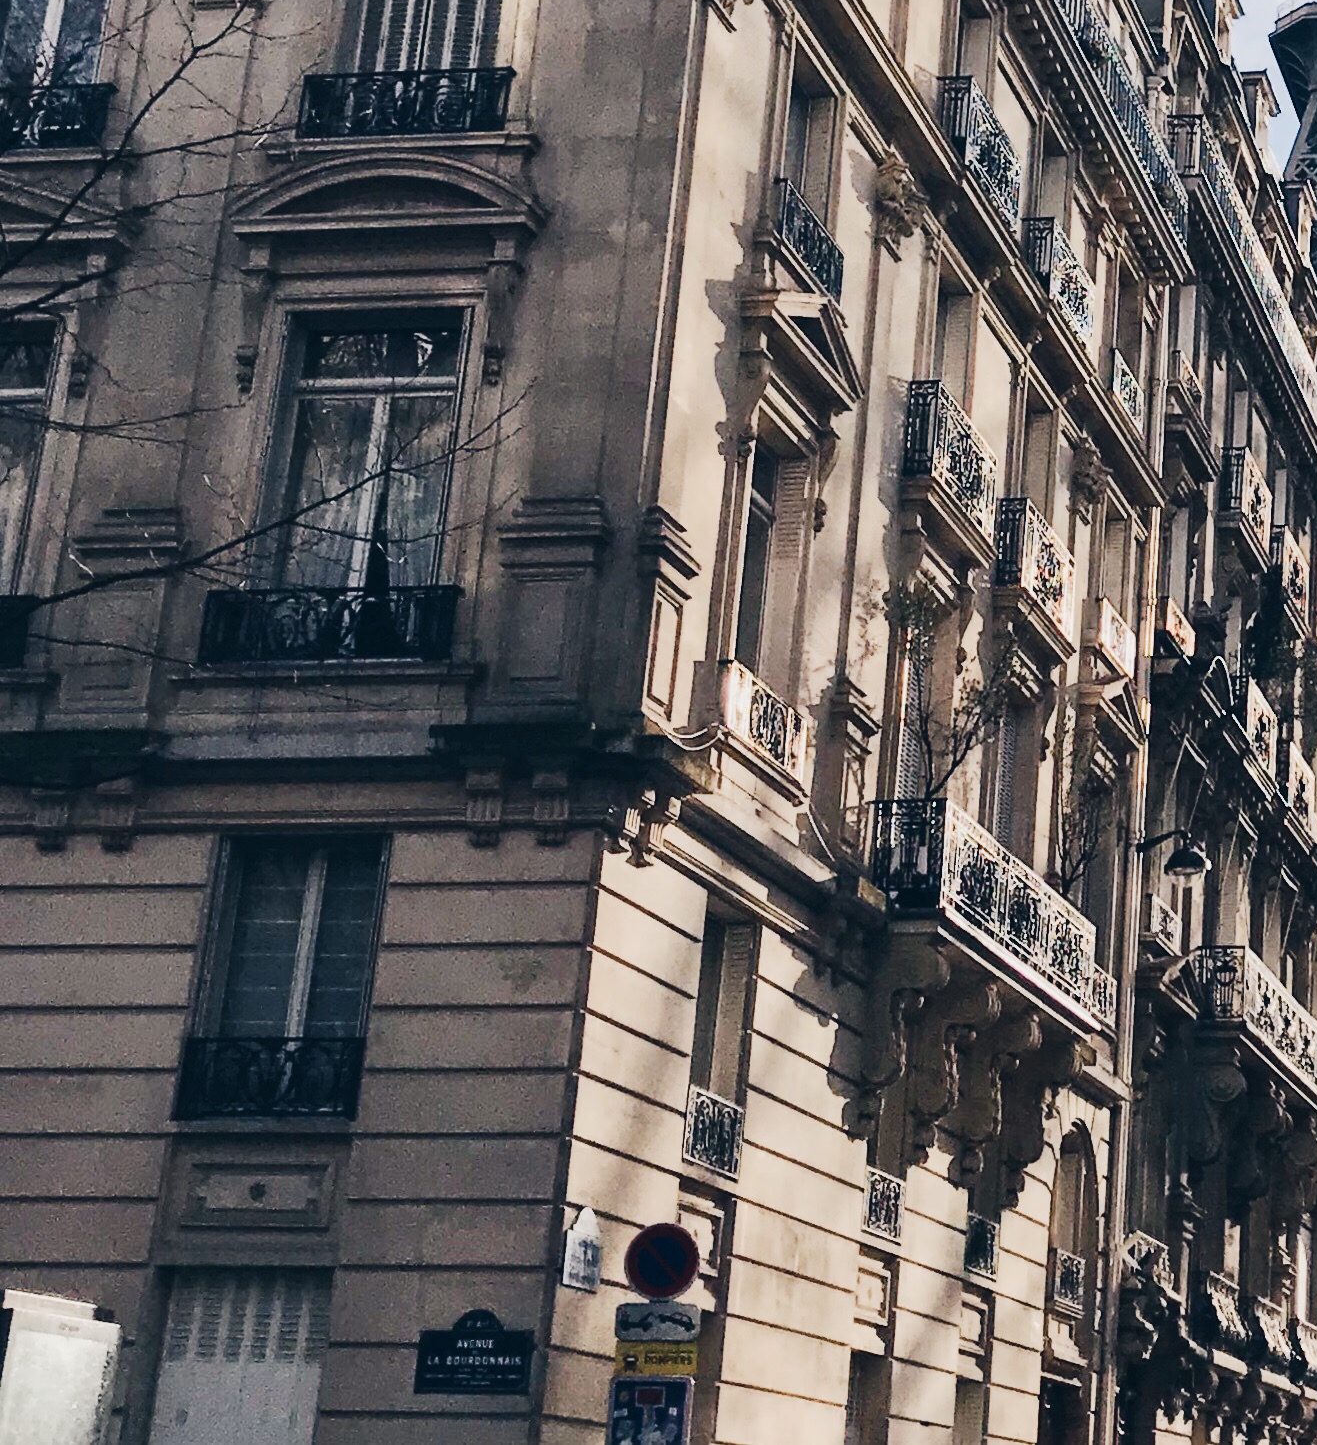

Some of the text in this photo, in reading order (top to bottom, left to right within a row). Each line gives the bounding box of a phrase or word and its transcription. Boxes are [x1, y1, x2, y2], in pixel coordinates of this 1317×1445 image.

[456, 1339, 495, 1349] AVENUE
[427, 1356, 522, 1365] LA BOURDONNAIS
[644, 1354, 693, 1365] POMPIERS
